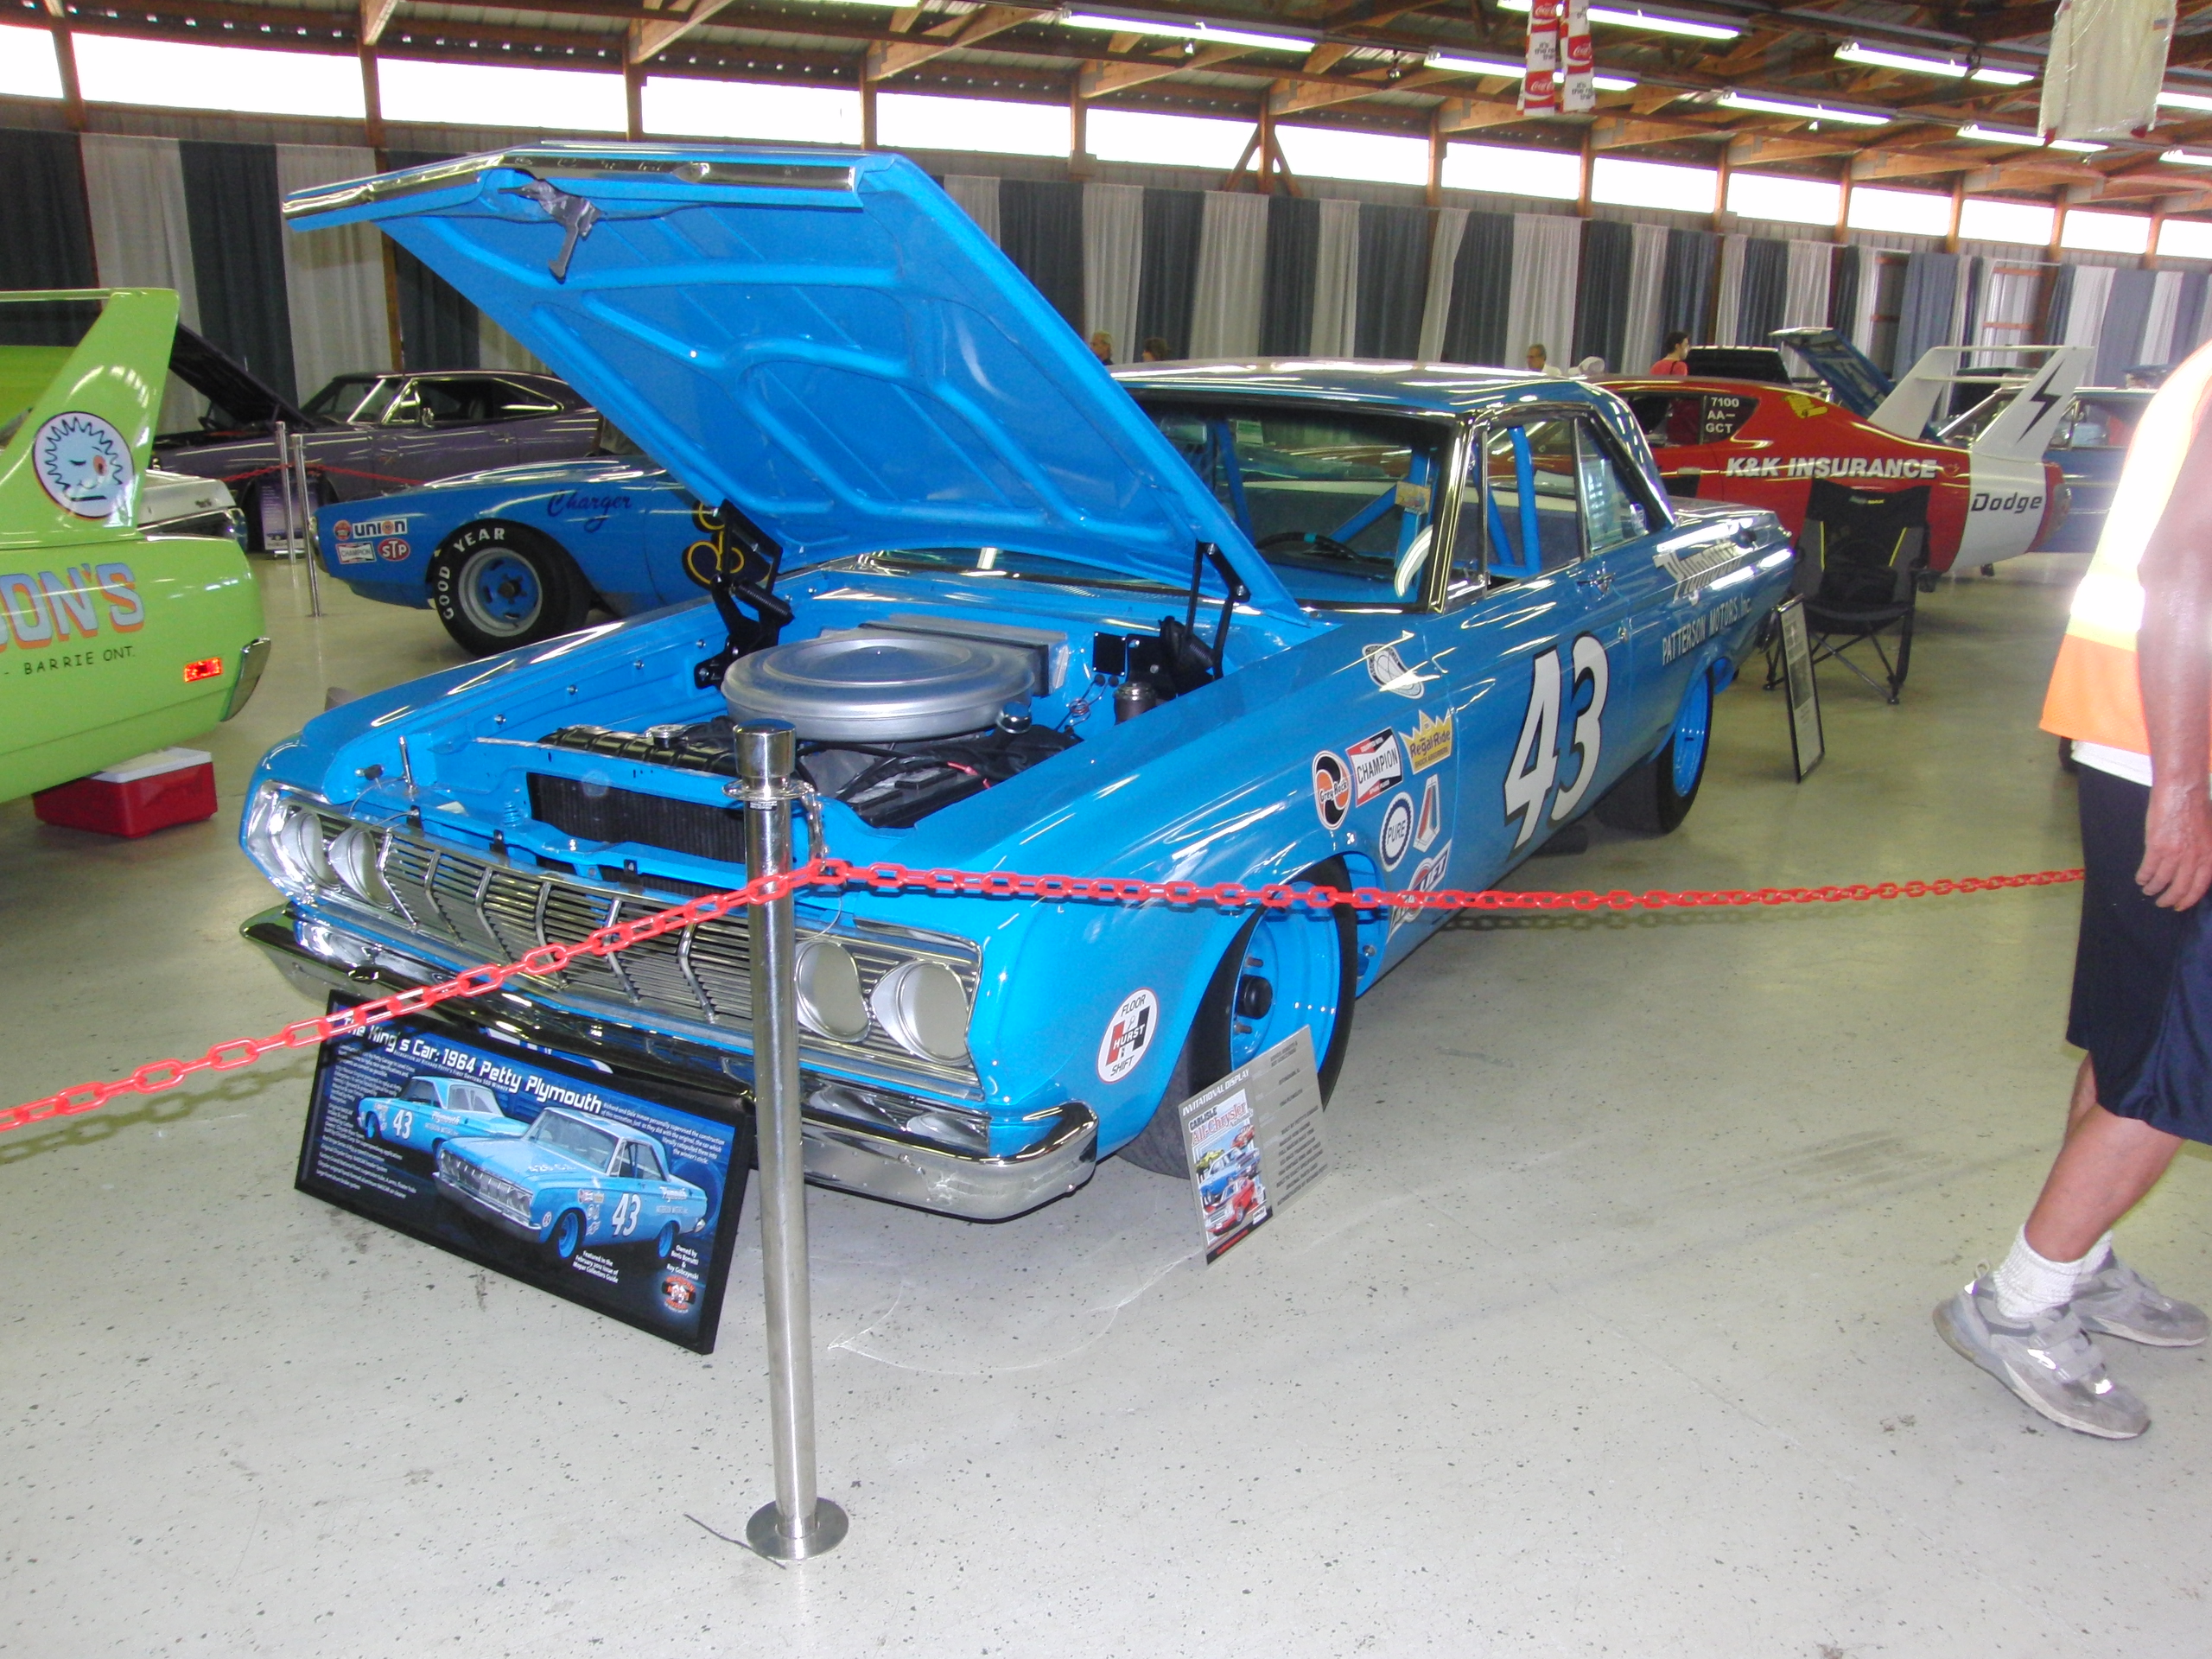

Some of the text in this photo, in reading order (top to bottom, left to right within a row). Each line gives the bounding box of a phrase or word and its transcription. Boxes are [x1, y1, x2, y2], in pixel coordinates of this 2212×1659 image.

[1710, 397, 1739, 408] 7100
[1706, 423, 1733, 433] GCT
[1726, 456, 1937, 480] K&K INSURANCE
[547, 492, 632, 533] Charger
[1970, 493, 2043, 515] Dodge
[354, 520, 406, 537] union
[453, 527, 505, 553] YEAR
[340, 548, 372, 557] CHAMPION
[382, 540, 407, 558] STP
[441, 564, 455, 620] GOOD
[0, 563, 145, 654] ON'S
[1662, 614, 1707, 666] PATTERSON
[24, 652, 94, 675] BARRIE
[103, 645, 136, 663] ONT.
[1503, 632, 1609, 861] 43
[1357, 747, 1398, 784] CHAMPION
[1386, 819, 1406, 846] PURE
[1121, 994, 1147, 1017] FLOOR
[1113, 1024, 1145, 1050] HURST
[412, 1038, 440, 1062] Car:
[442, 1048, 477, 1074] 1964
[479, 1060, 522, 1094] Petty
[524, 1075, 602, 1114] Plymouth
[1110, 1055, 1135, 1077] SHIFT
[1182, 1084, 1224, 1116] INVITATIONAL
[1224, 1068, 1250, 1090] DISPLAY
[393, 1109, 412, 1140] 43
[1190, 1106, 1217, 1131] CARLISLE
[1191, 1100, 1246, 1146] All-Chrysler
[612, 1192, 641, 1237] 43
